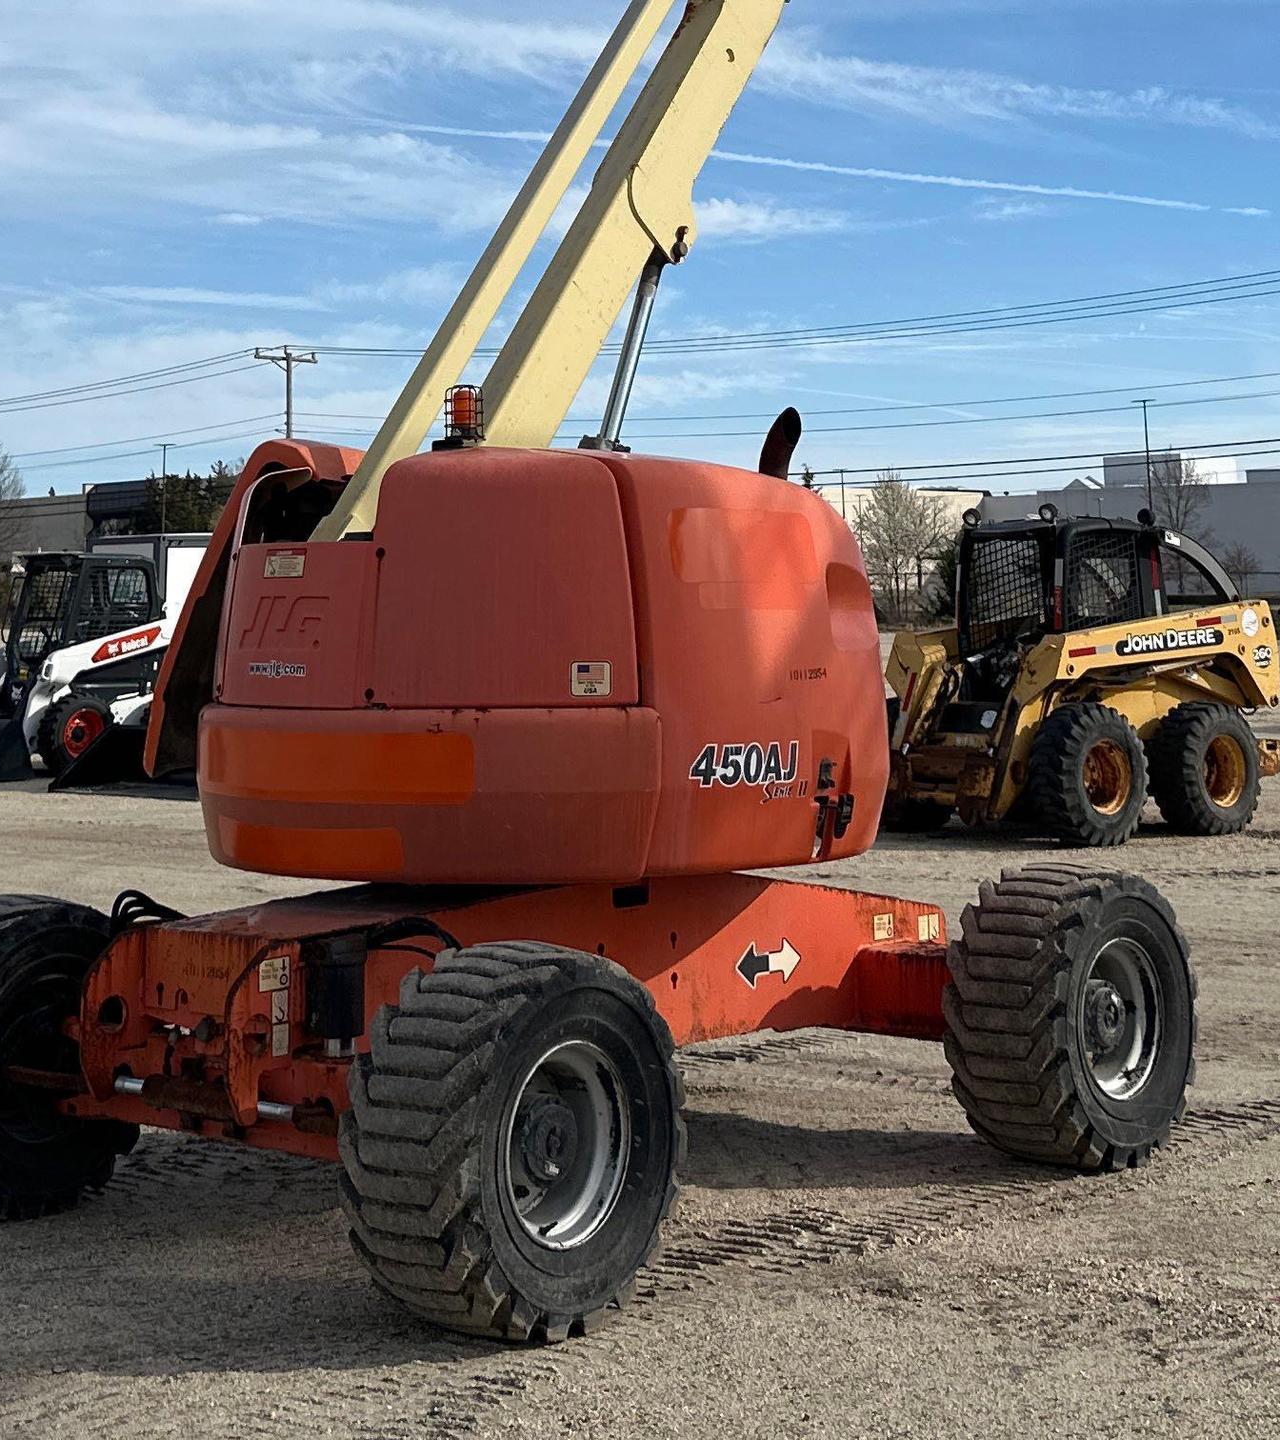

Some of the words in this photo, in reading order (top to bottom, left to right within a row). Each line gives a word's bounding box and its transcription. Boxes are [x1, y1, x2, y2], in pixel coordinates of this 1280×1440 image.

[239, 595, 330, 650] JLG
[121, 635, 149, 653] Bobcat
[1123, 632, 1165, 653] JOHN
[1166, 627, 1217, 648] DEERE
[1252, 646, 1273, 660] 260
[249, 660, 306, 677] www.jlg.com
[689, 740, 800, 788] 450AJ
